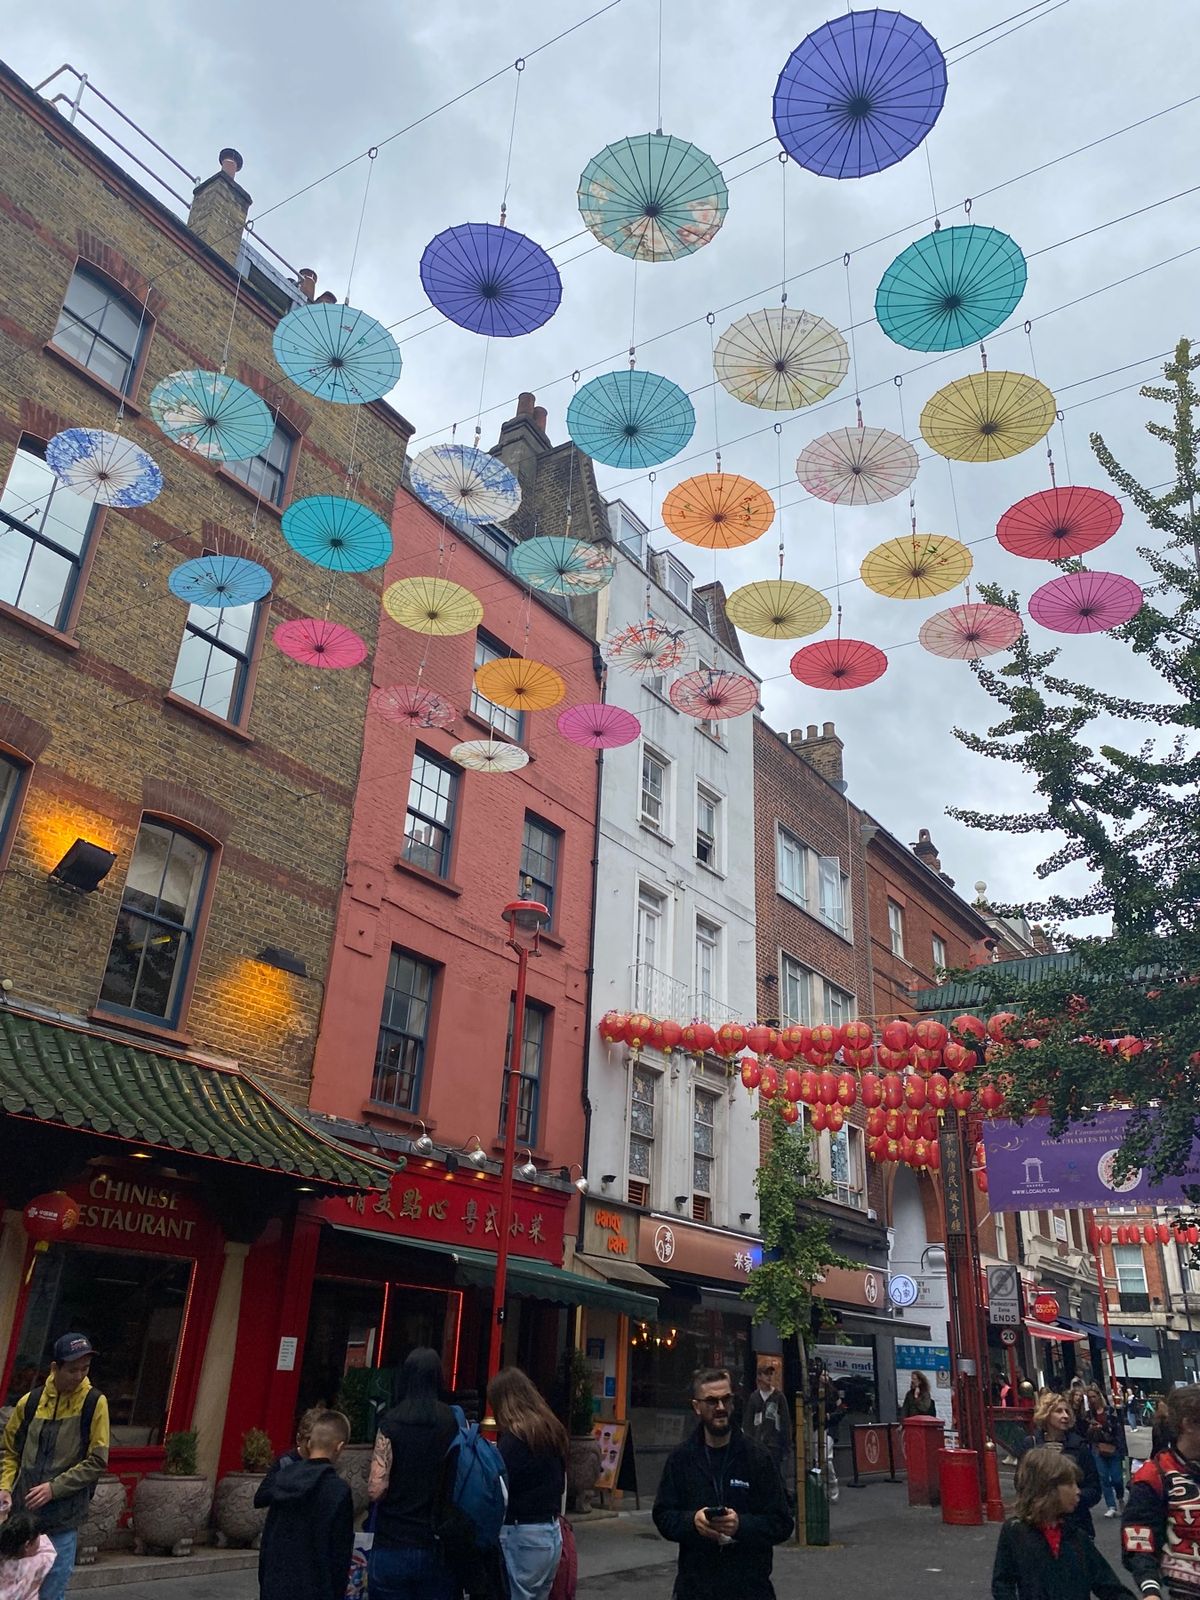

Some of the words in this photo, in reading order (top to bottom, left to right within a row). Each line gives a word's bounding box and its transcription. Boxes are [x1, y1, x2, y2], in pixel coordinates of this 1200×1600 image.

[1062, 1135, 1098, 1145] CHARLES
[89, 1176, 181, 1211] CHINESE
[78, 1204, 196, 1241] ESTAURANT
[595, 1209, 623, 1234] candy
[607, 1235, 629, 1255] cafe
[733, 1252, 753, 1274] 米家
[993, 1314, 1016, 1322] ENDS
[1003, 1332, 1014, 1340] 20
